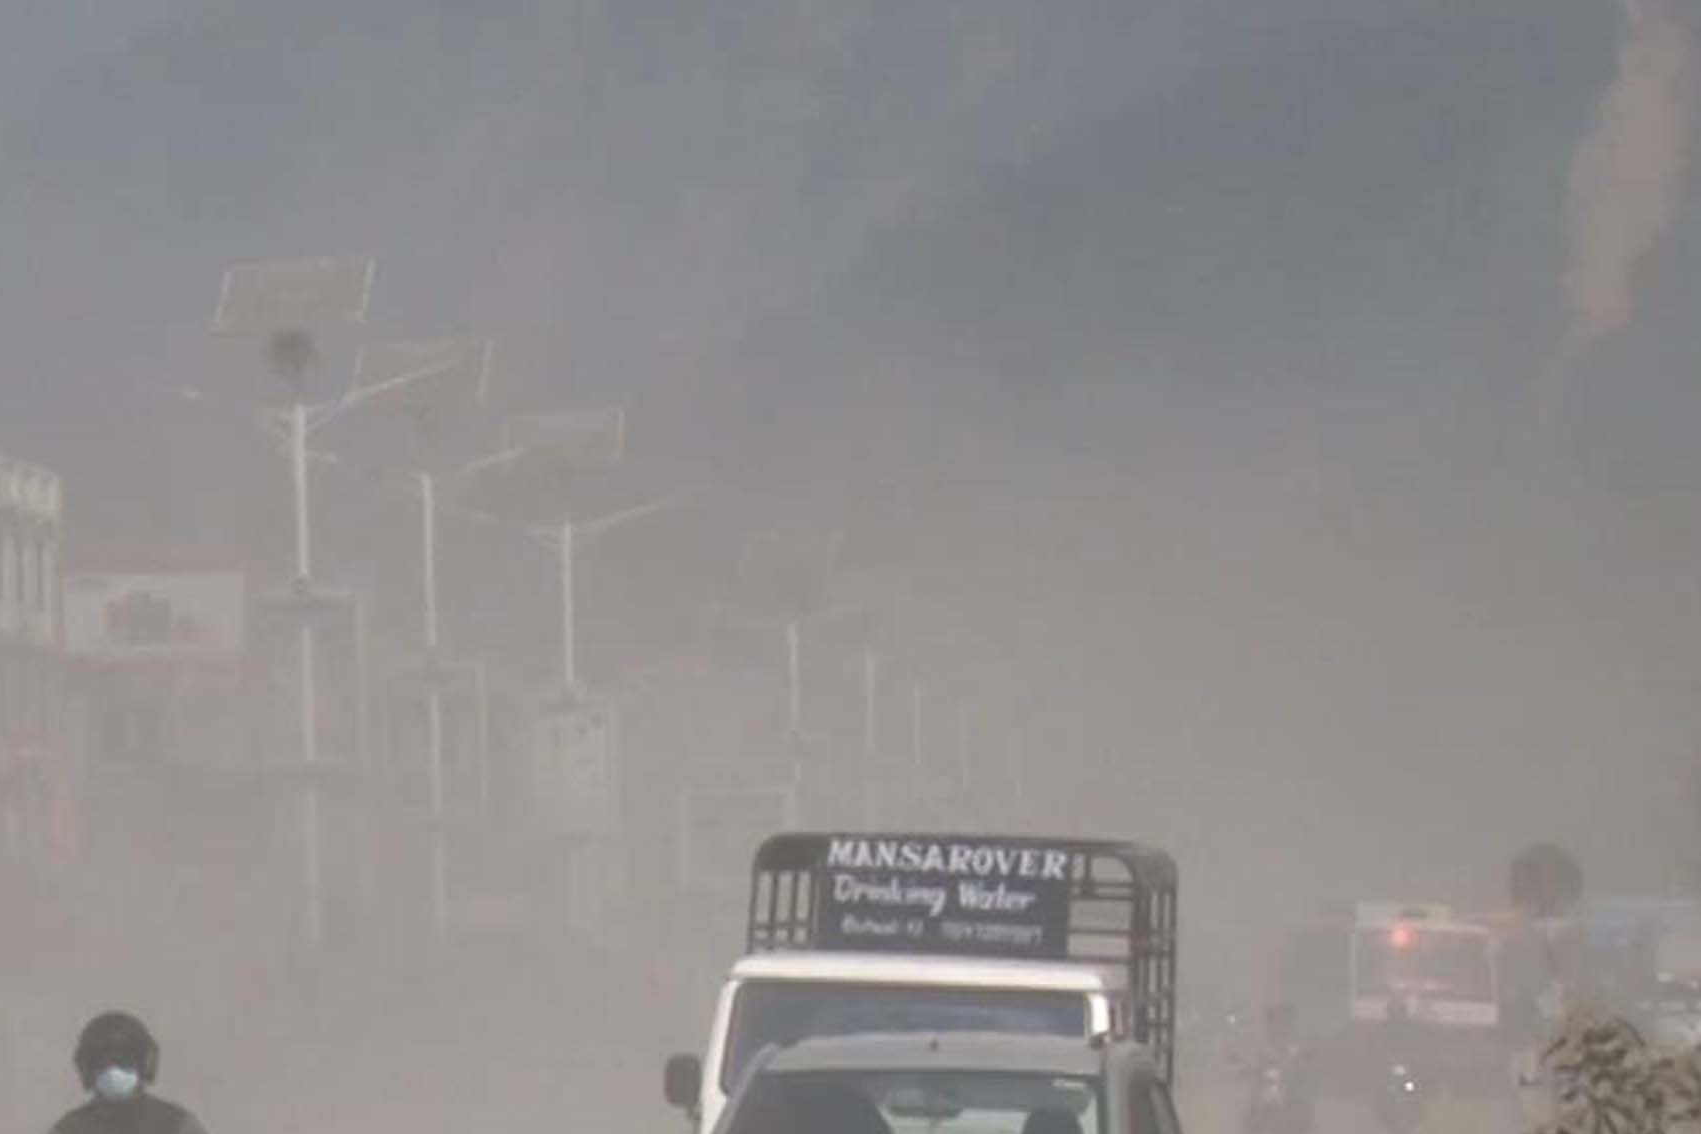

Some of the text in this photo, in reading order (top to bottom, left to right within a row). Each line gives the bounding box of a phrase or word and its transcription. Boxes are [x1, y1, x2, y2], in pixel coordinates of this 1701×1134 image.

[828, 840, 1066, 879] MANSAROVER
[836, 874, 1037, 916] Drinking Water
